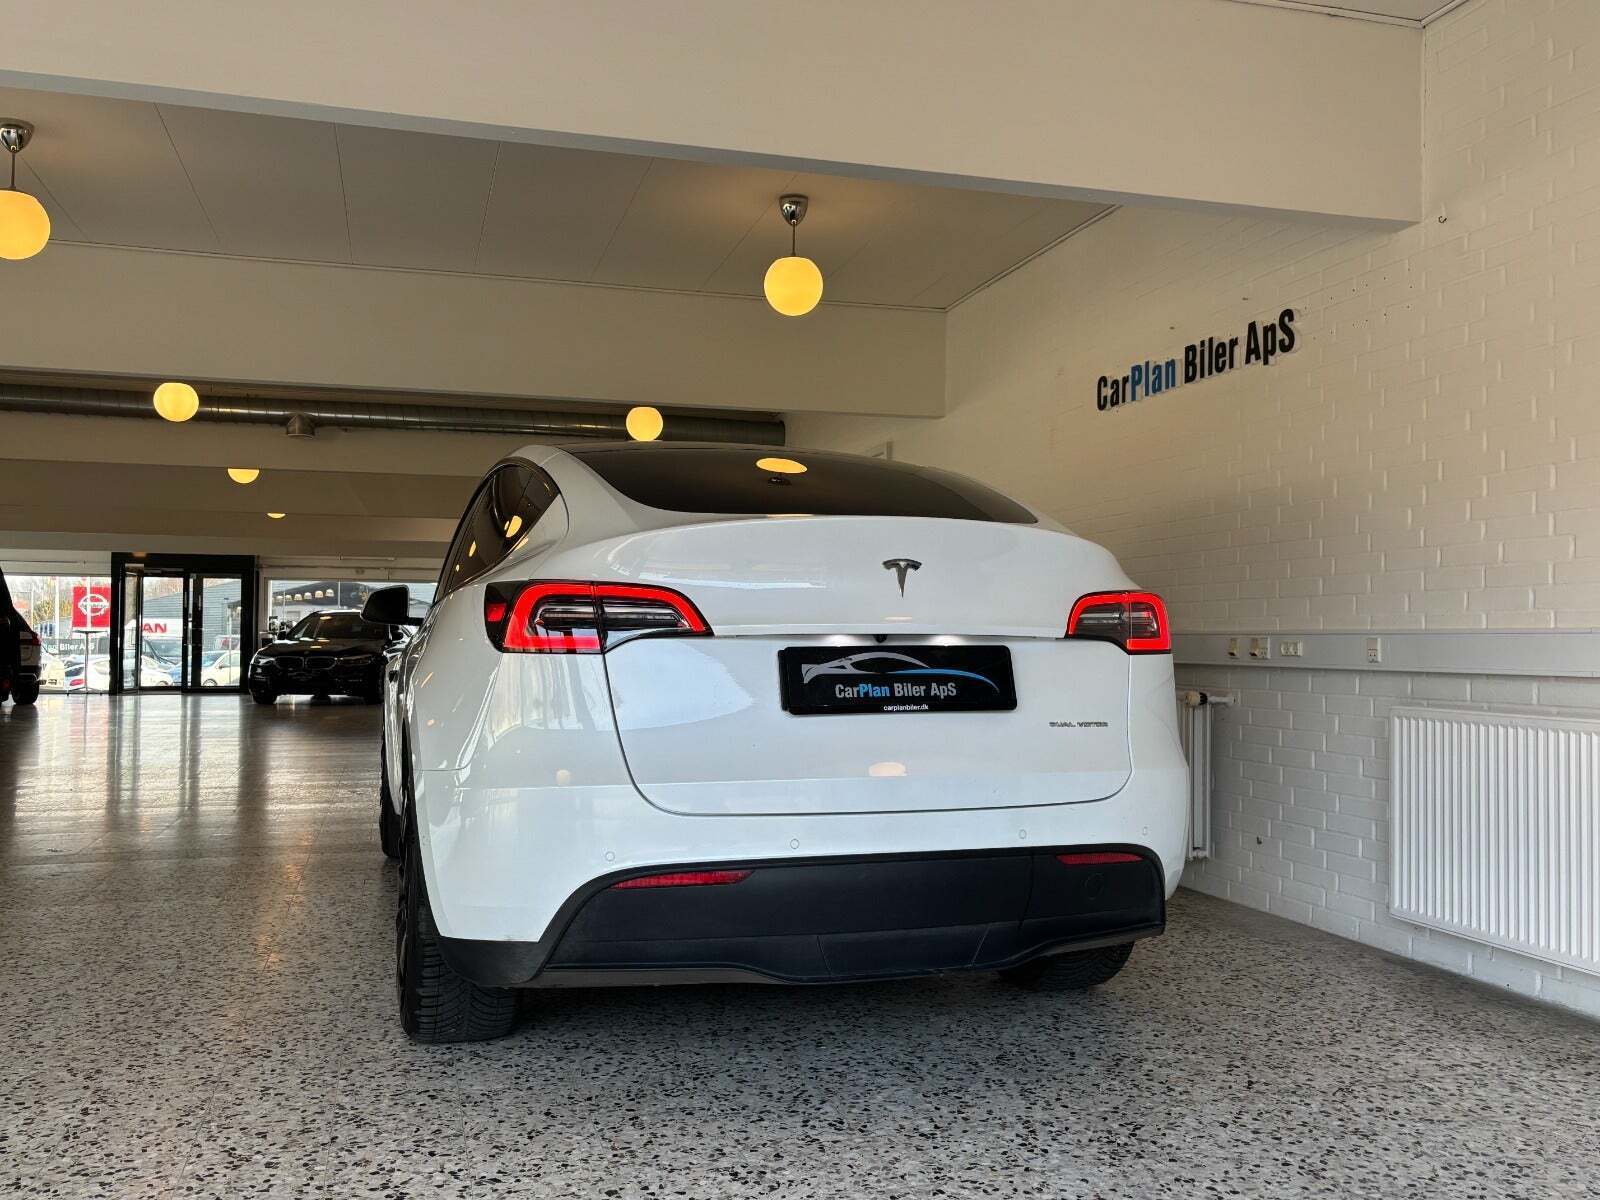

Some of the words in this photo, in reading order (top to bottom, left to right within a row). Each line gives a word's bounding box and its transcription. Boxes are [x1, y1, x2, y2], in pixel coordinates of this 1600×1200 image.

[1096, 358, 1176, 411] CarPlan
[1184, 336, 1239, 384] Biler
[1245, 308, 1295, 365] ApS
[835, 682, 890, 698] CarPlan
[894, 682, 926, 697] Biler
[930, 682, 957, 700] ApS
[883, 703, 929, 712] carplanbiler.dk
